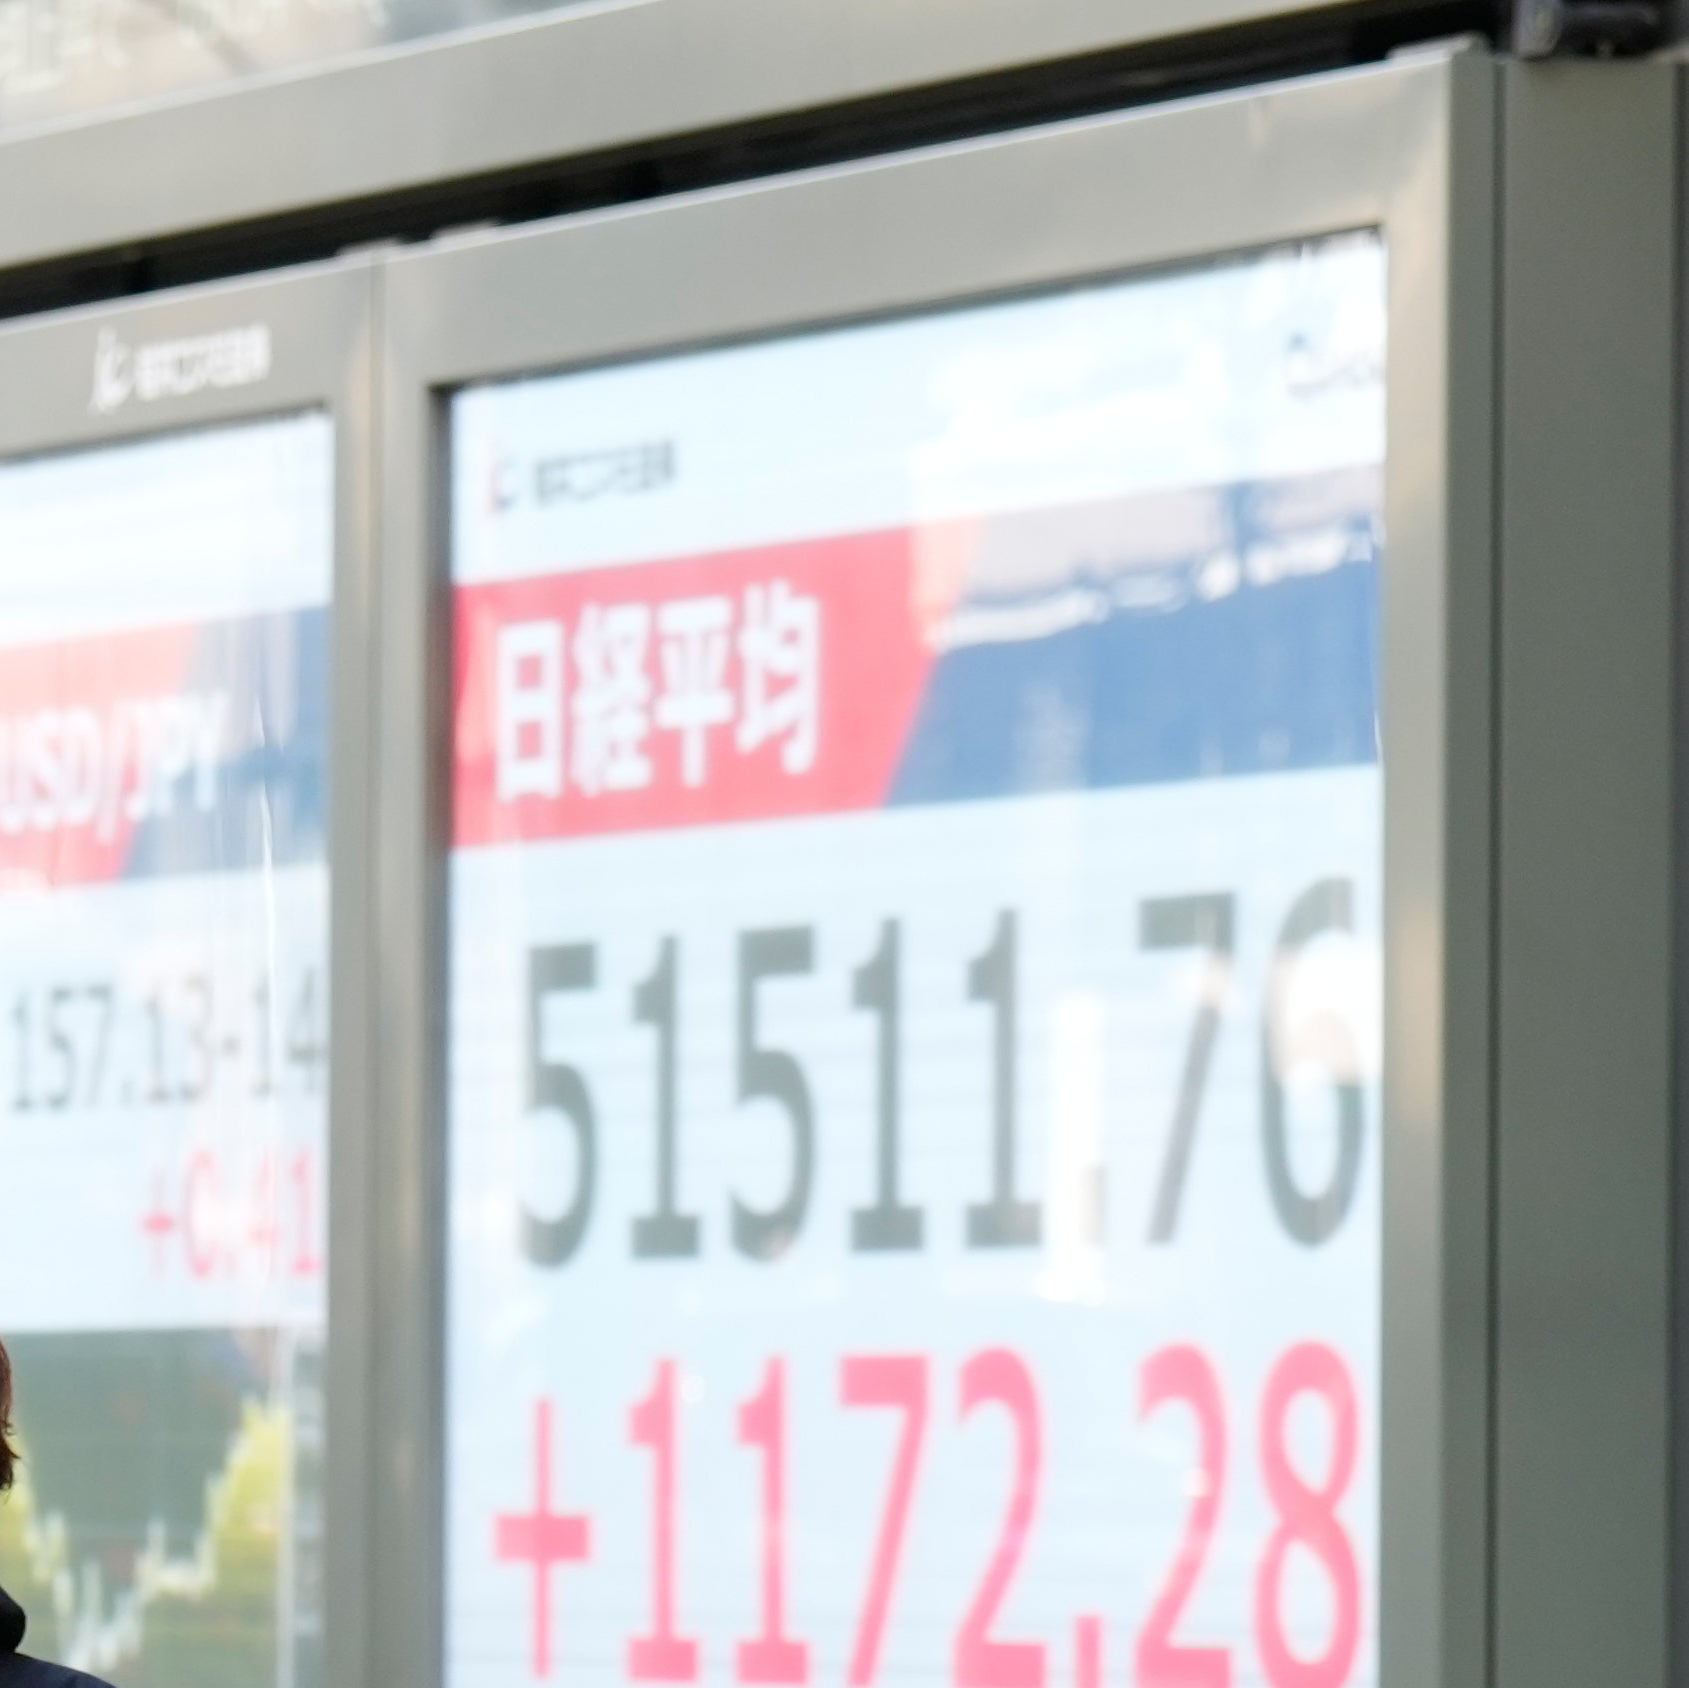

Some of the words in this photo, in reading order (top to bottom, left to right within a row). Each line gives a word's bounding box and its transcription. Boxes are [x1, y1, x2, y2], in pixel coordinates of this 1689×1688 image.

[495, 578, 822, 801] 日経平均
[513, 876, 1366, 1271] 51511.76
